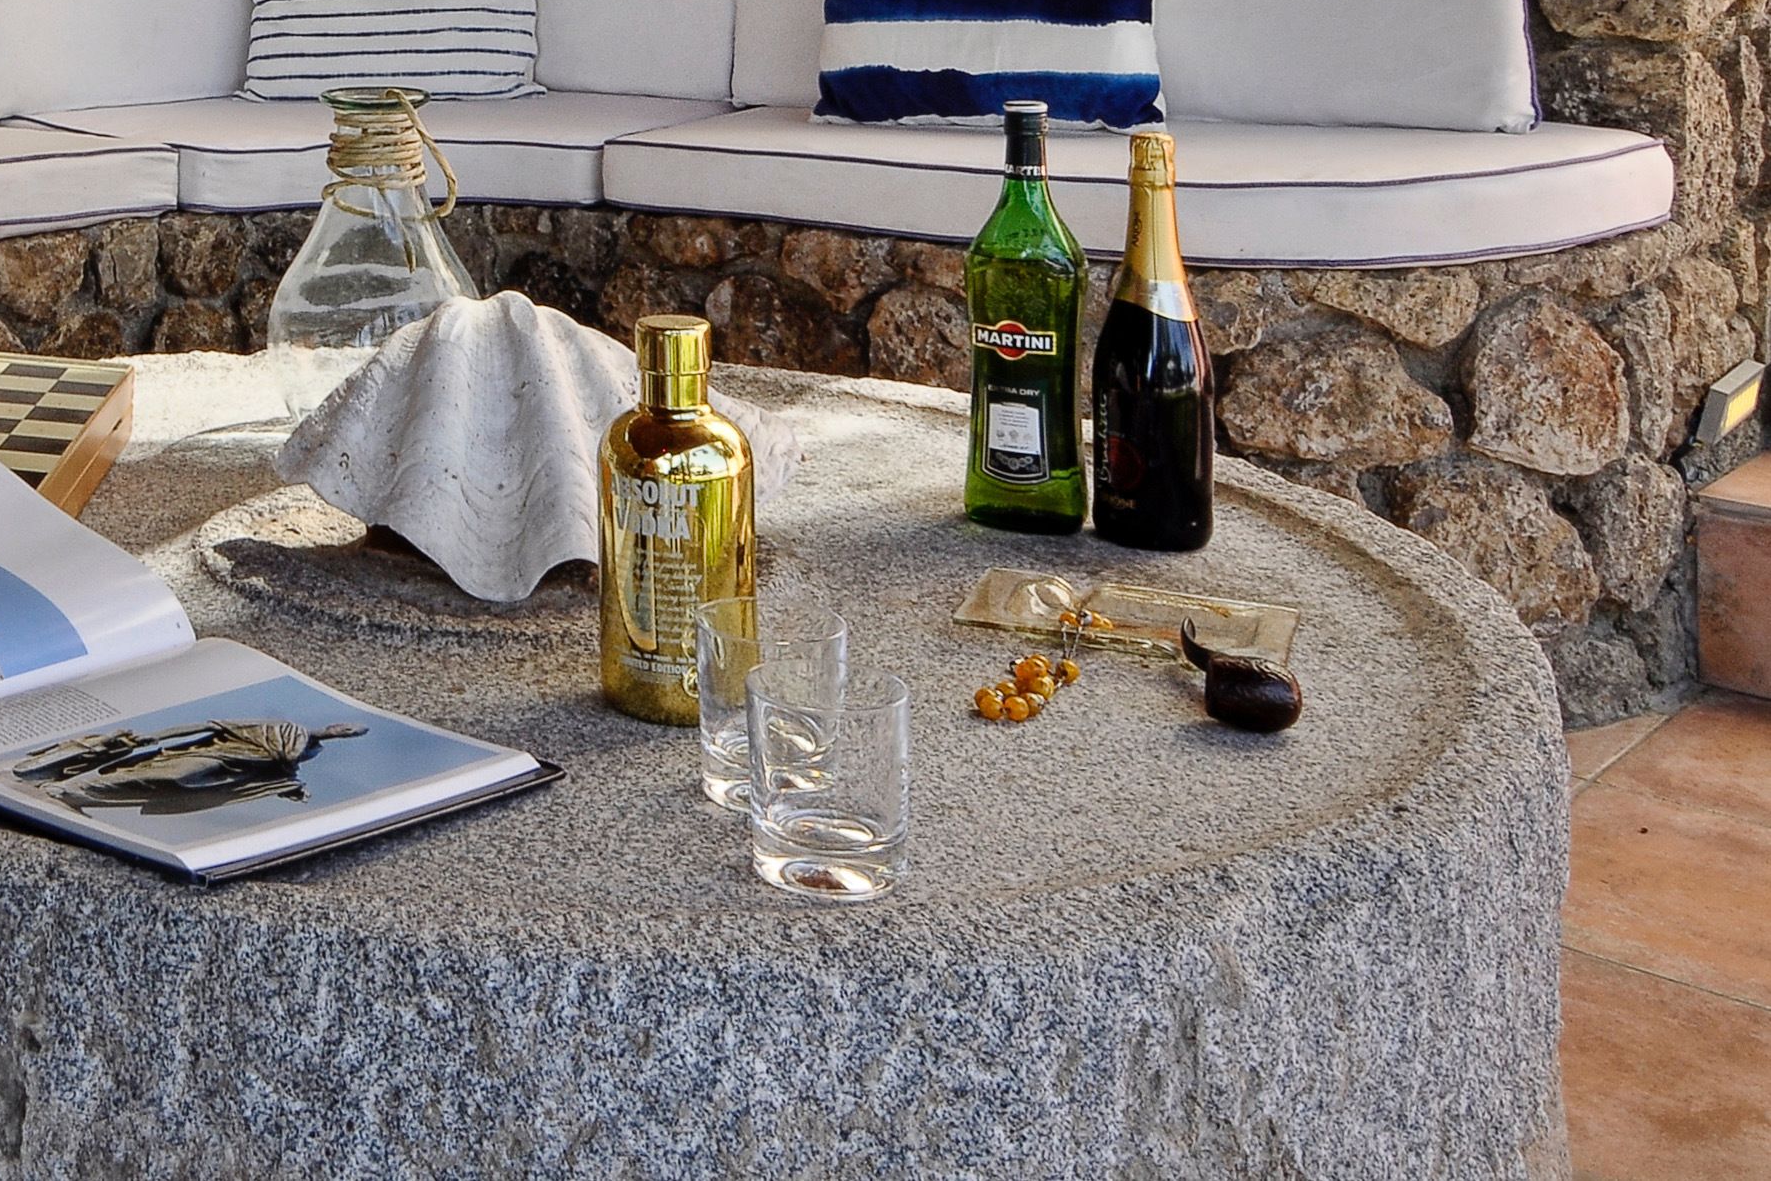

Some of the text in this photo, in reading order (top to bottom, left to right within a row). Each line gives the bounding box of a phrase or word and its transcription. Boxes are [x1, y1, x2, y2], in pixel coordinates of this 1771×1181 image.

[977, 329, 1051, 350] MARTINI
[1019, 388, 1040, 397] DRY
[611, 473, 700, 508] ABSOLUT
[615, 503, 691, 539] VODKA
